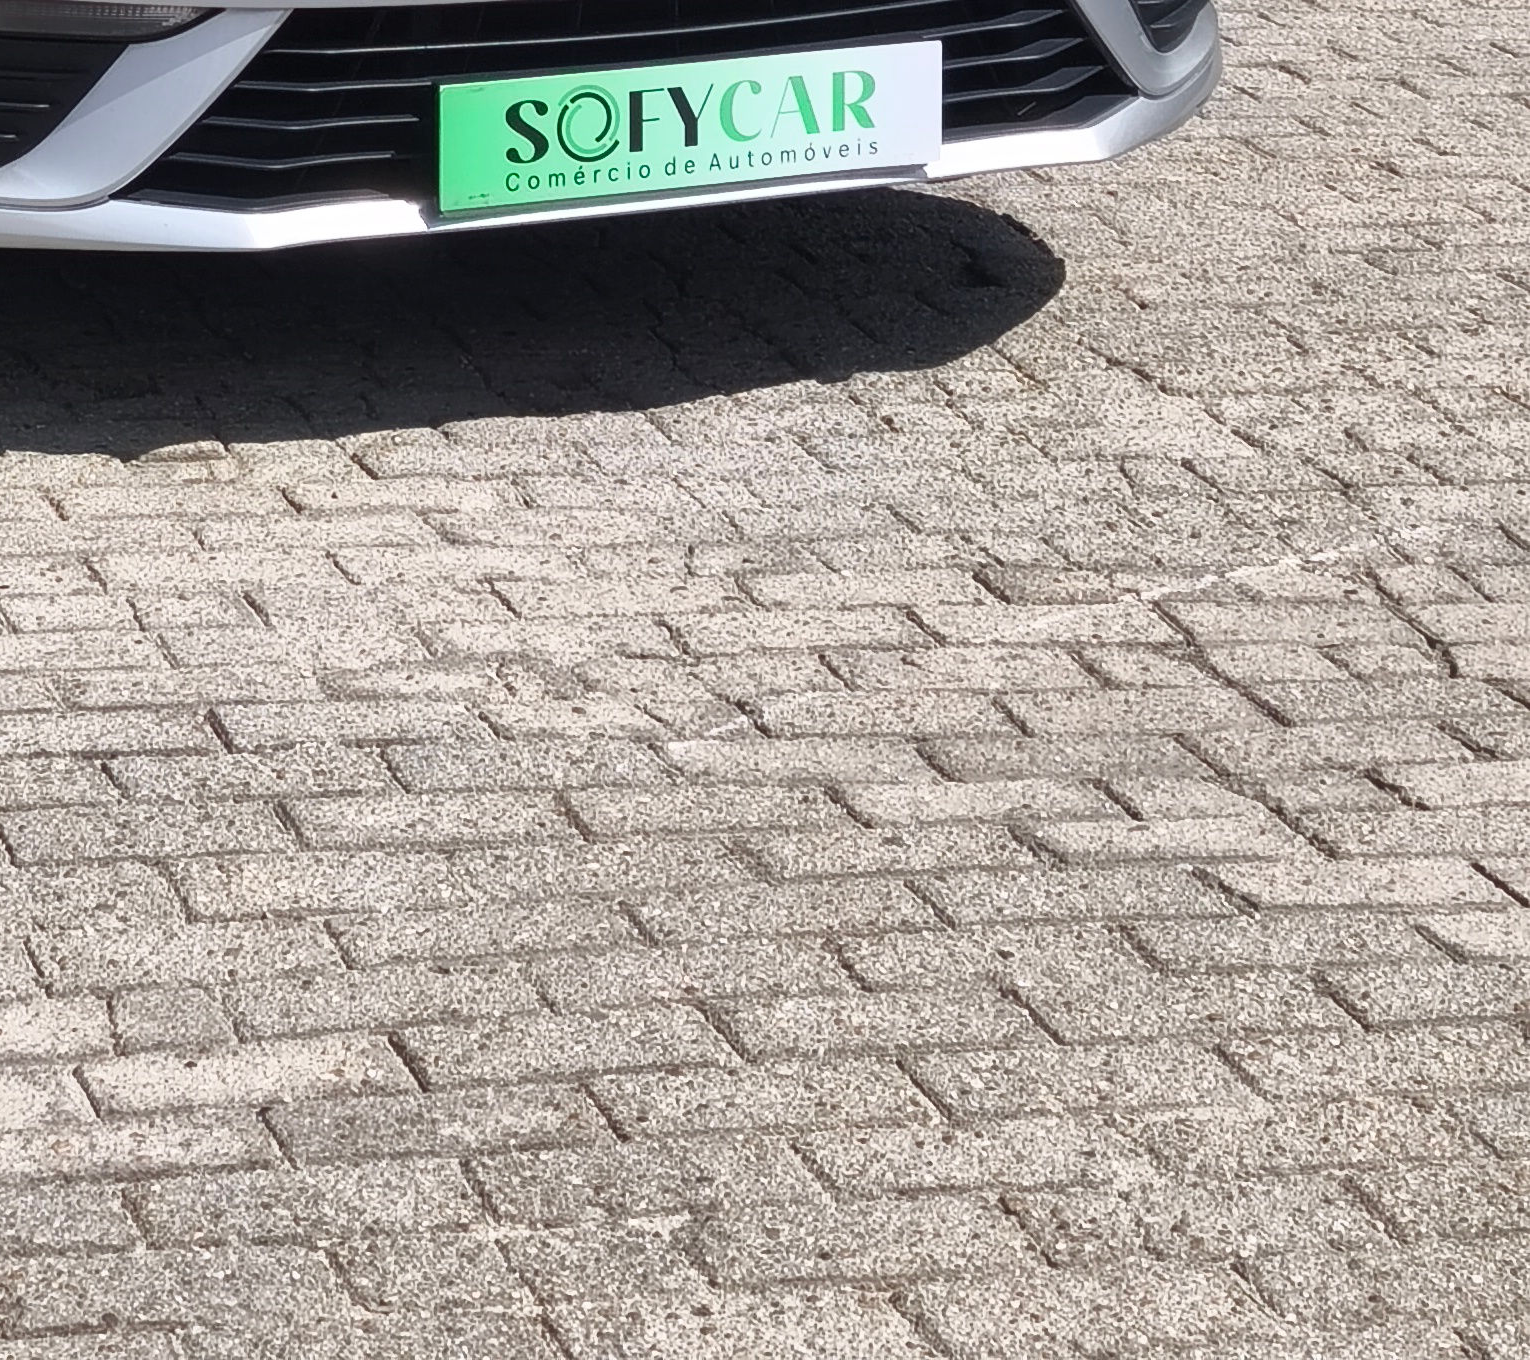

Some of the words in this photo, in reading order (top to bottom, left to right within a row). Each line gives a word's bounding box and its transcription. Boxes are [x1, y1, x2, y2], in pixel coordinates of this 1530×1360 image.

[504, 70, 877, 165] SOFYCAR
[505, 162, 651, 193] Comércio
[664, 156, 696, 177] de
[708, 138, 879, 173] Automóveis
